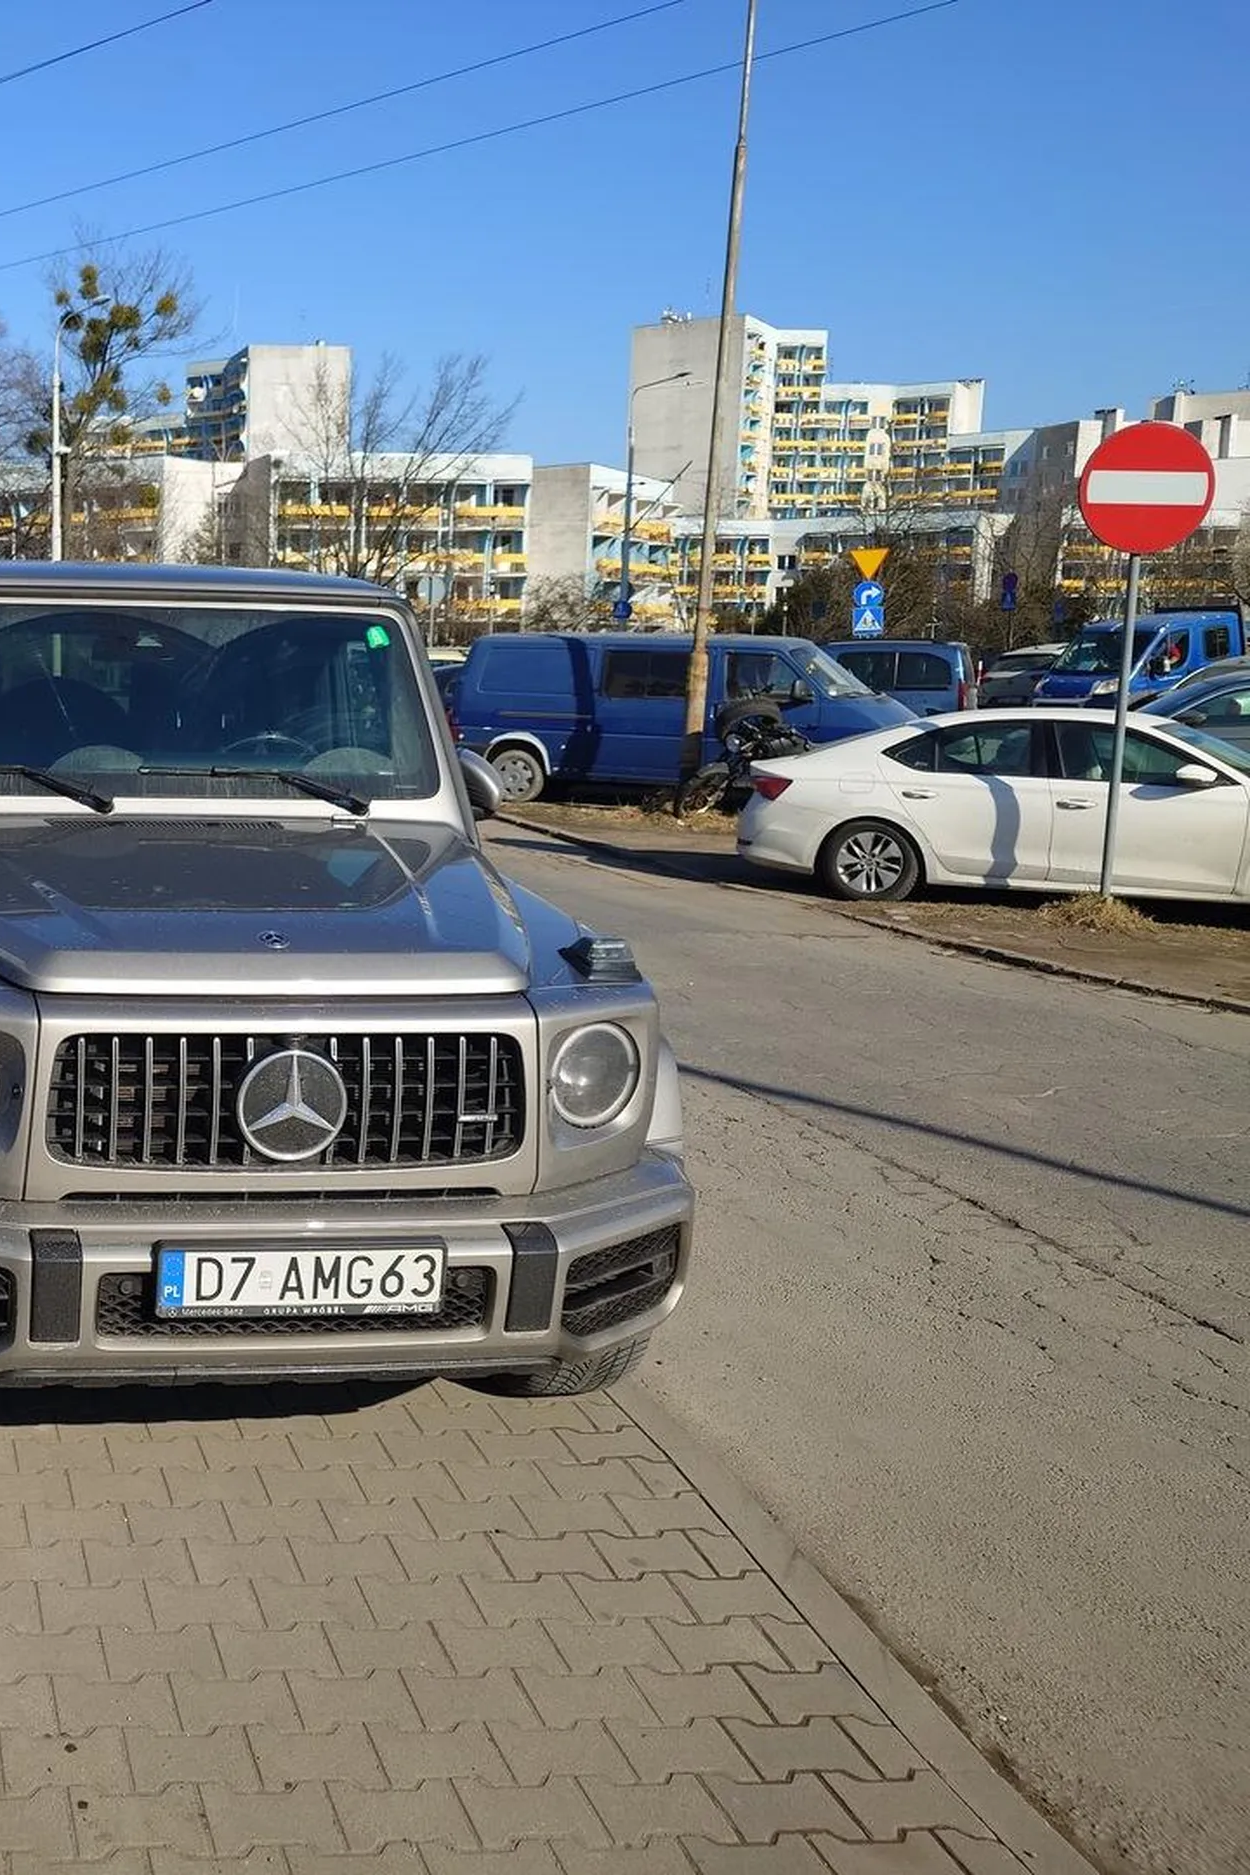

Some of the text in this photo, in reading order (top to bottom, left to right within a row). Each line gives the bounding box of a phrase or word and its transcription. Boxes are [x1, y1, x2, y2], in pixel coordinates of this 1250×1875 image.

[195, 1254, 436, 1302] D7 AMG63
[164, 1286, 180, 1298] PL
[181, 1307, 244, 1316] Mercedes-Benz
[388, 1304, 434, 1313] AMG
